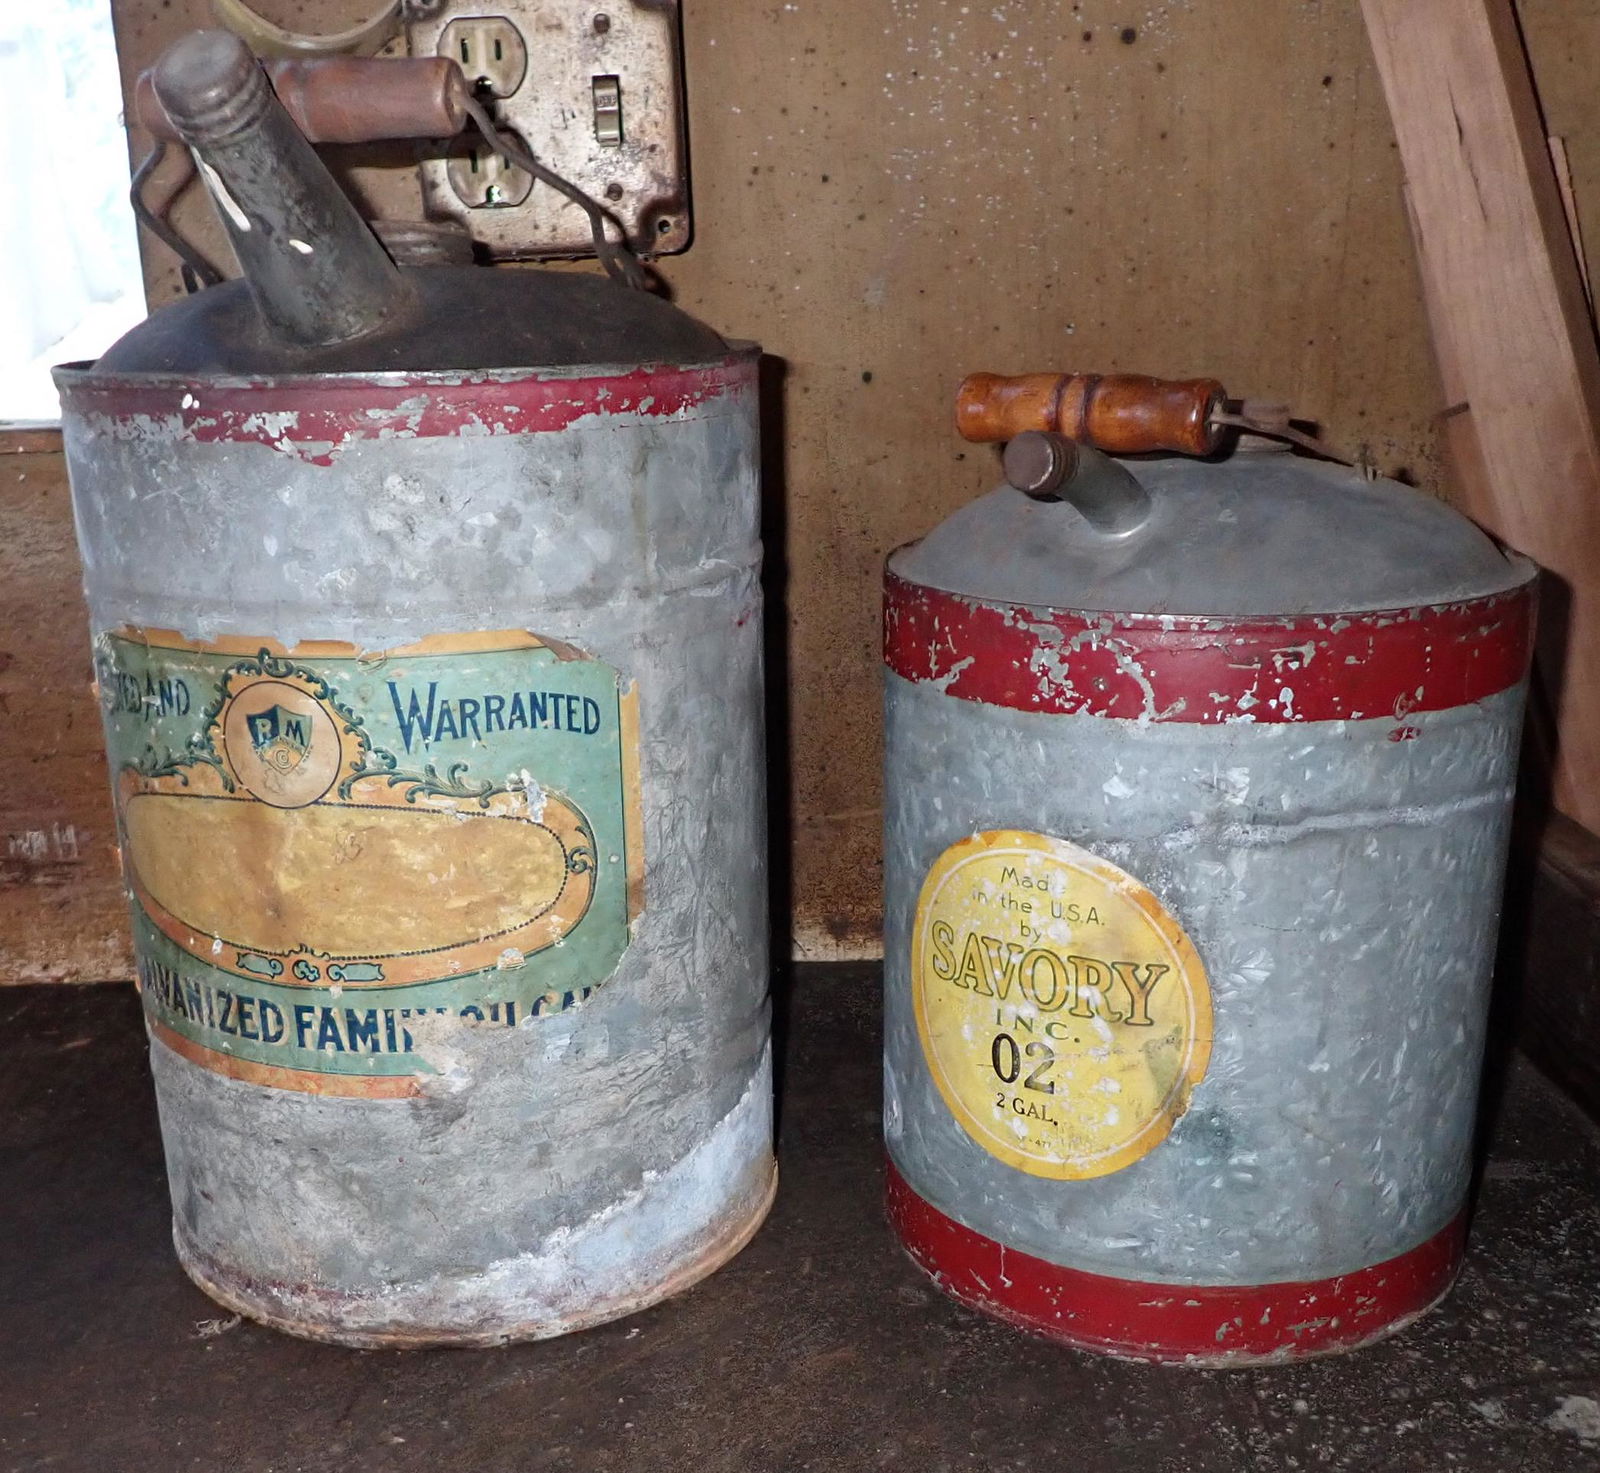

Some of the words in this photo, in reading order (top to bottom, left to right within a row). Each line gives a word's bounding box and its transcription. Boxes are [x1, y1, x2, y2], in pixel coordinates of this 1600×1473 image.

[144, 669, 191, 723] AND
[387, 681, 600, 754] WARRANTED
[1000, 866, 1066, 894] Mad
[1001, 892, 1033, 914] the
[1050, 899, 1106, 926] U.S.A.
[1020, 919, 1042, 943] by
[932, 920, 1170, 1027] SAVORY
[996, 1008, 1081, 1044] INC.
[991, 1033, 1055, 1095] 02
[996, 1092, 1006, 1109] 2
[1012, 1097, 1059, 1127] GAL.
